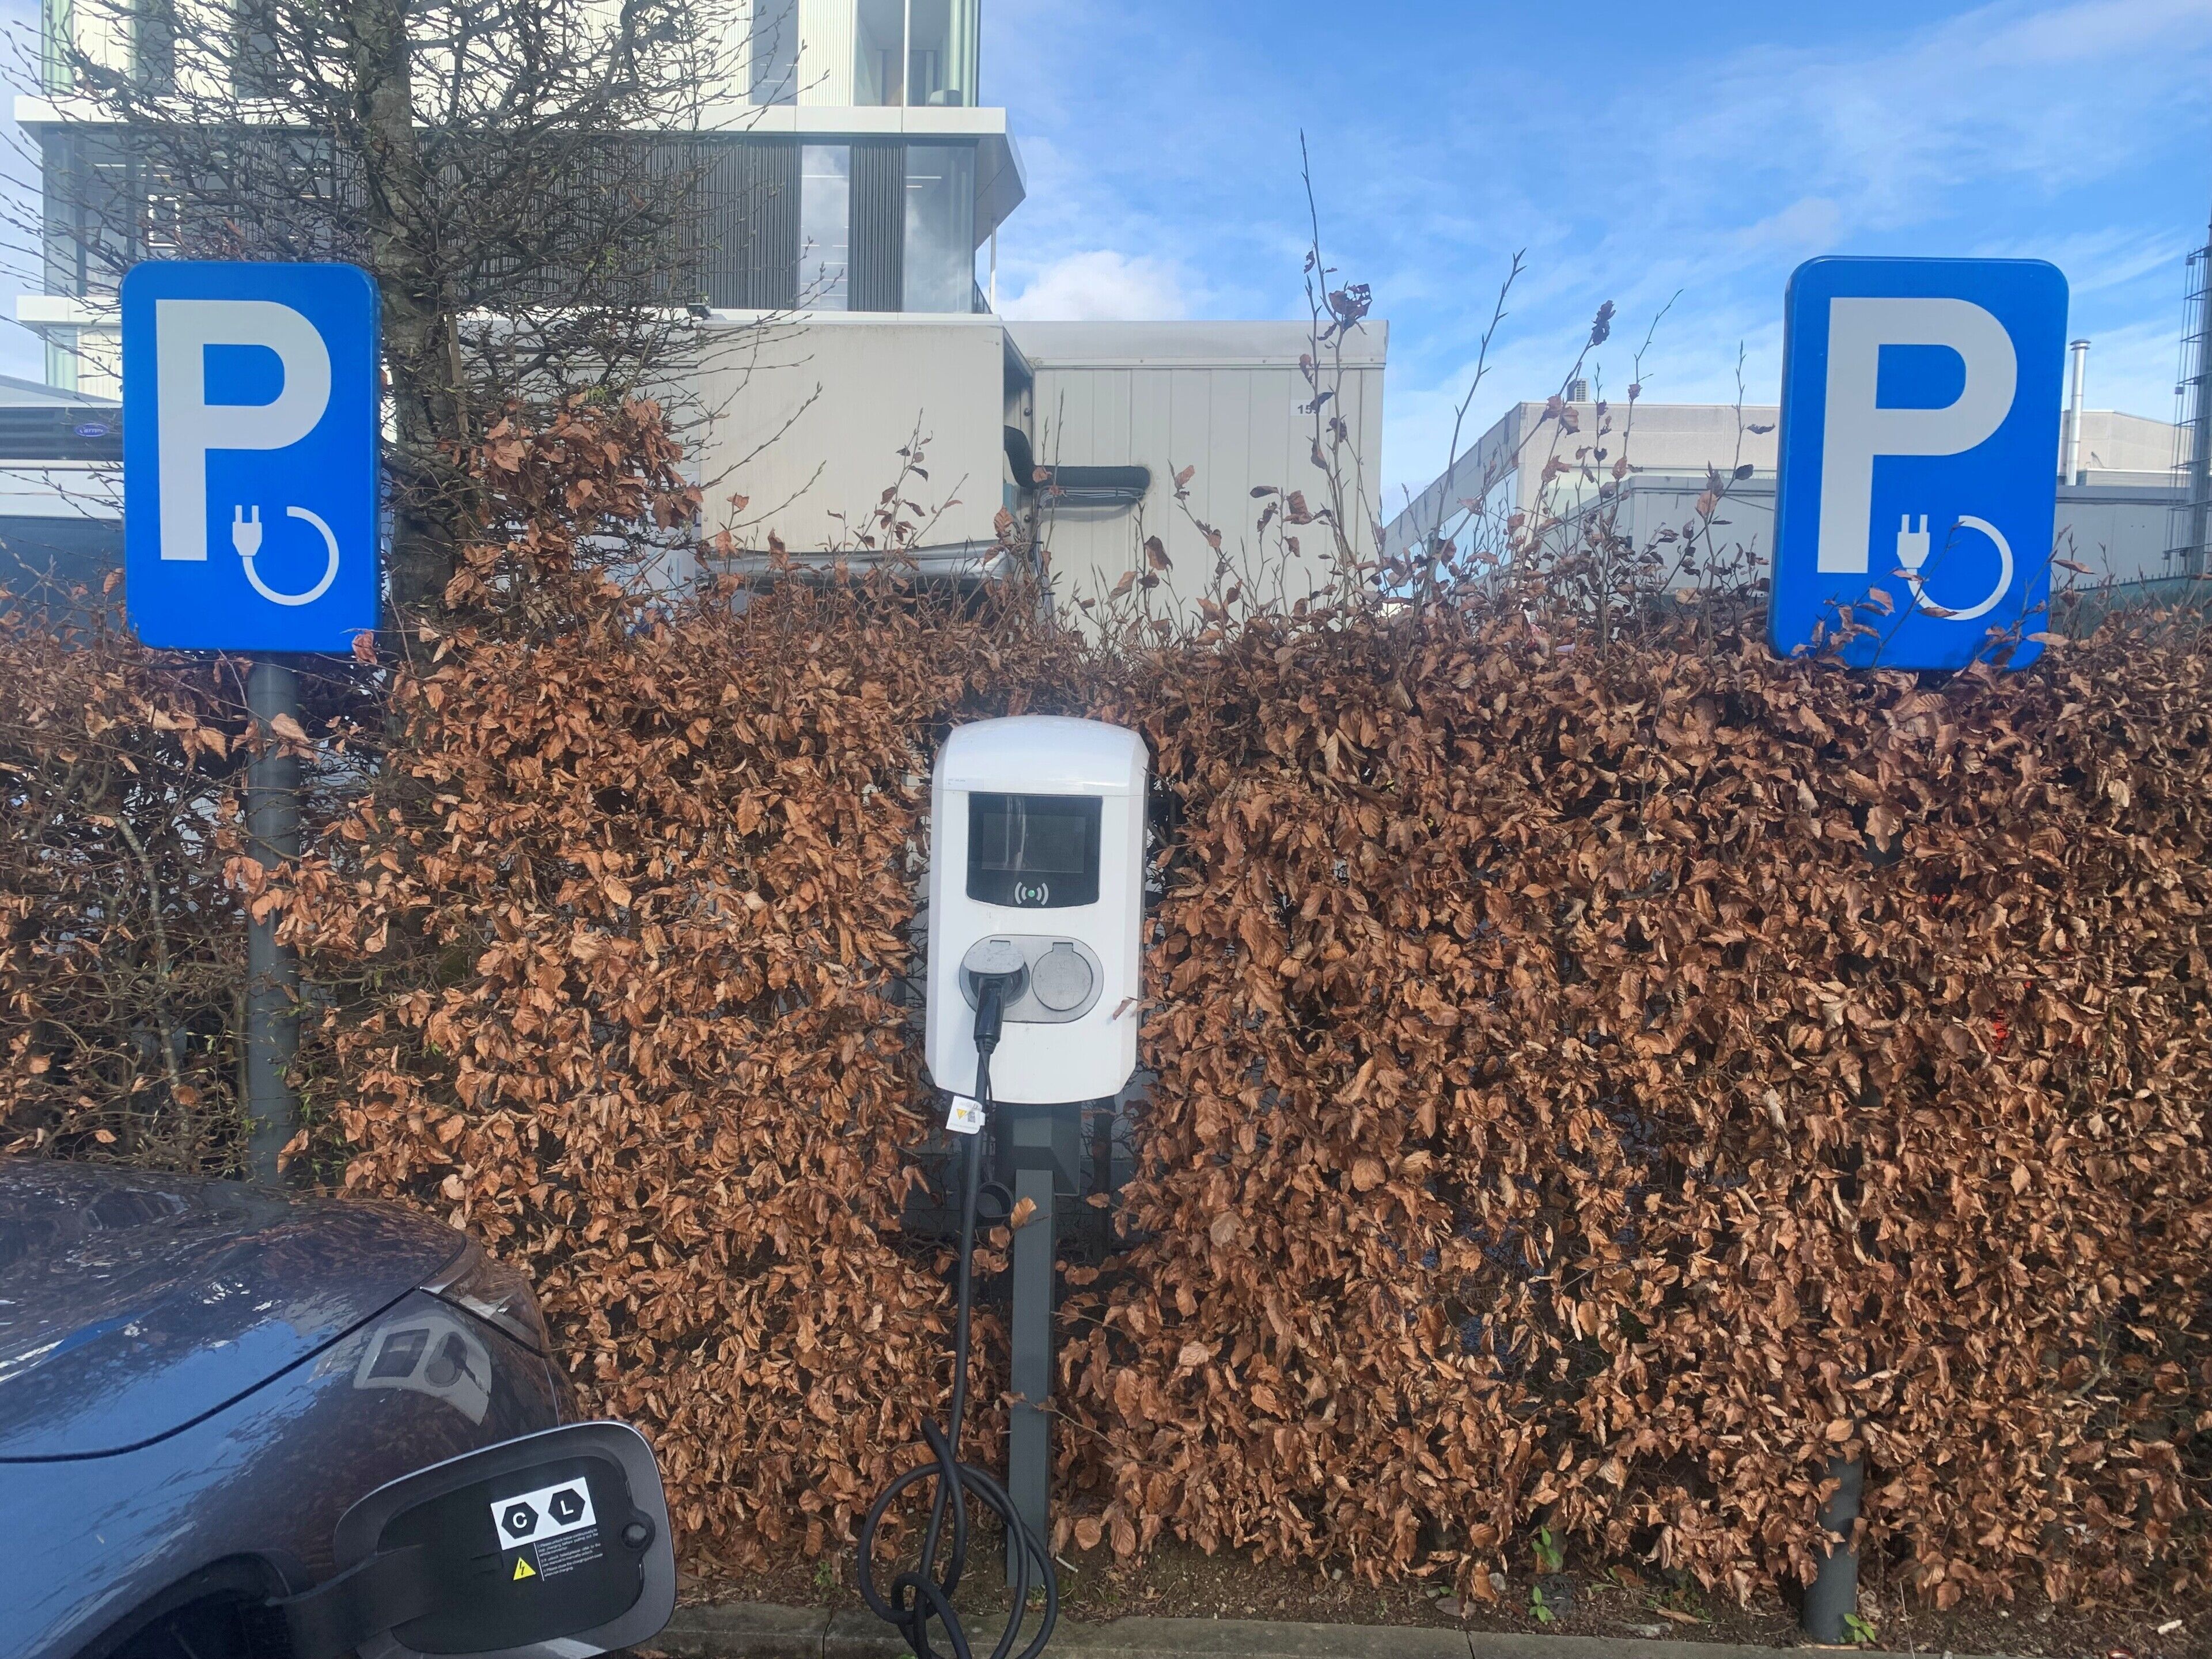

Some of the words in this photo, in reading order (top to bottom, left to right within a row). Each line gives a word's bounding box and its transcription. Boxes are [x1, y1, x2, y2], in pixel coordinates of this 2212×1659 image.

[156, 300, 331, 560] P
[1817, 298, 2017, 573] P
[512, 1512, 528, 1528] C
[560, 1500, 574, 1515] L
